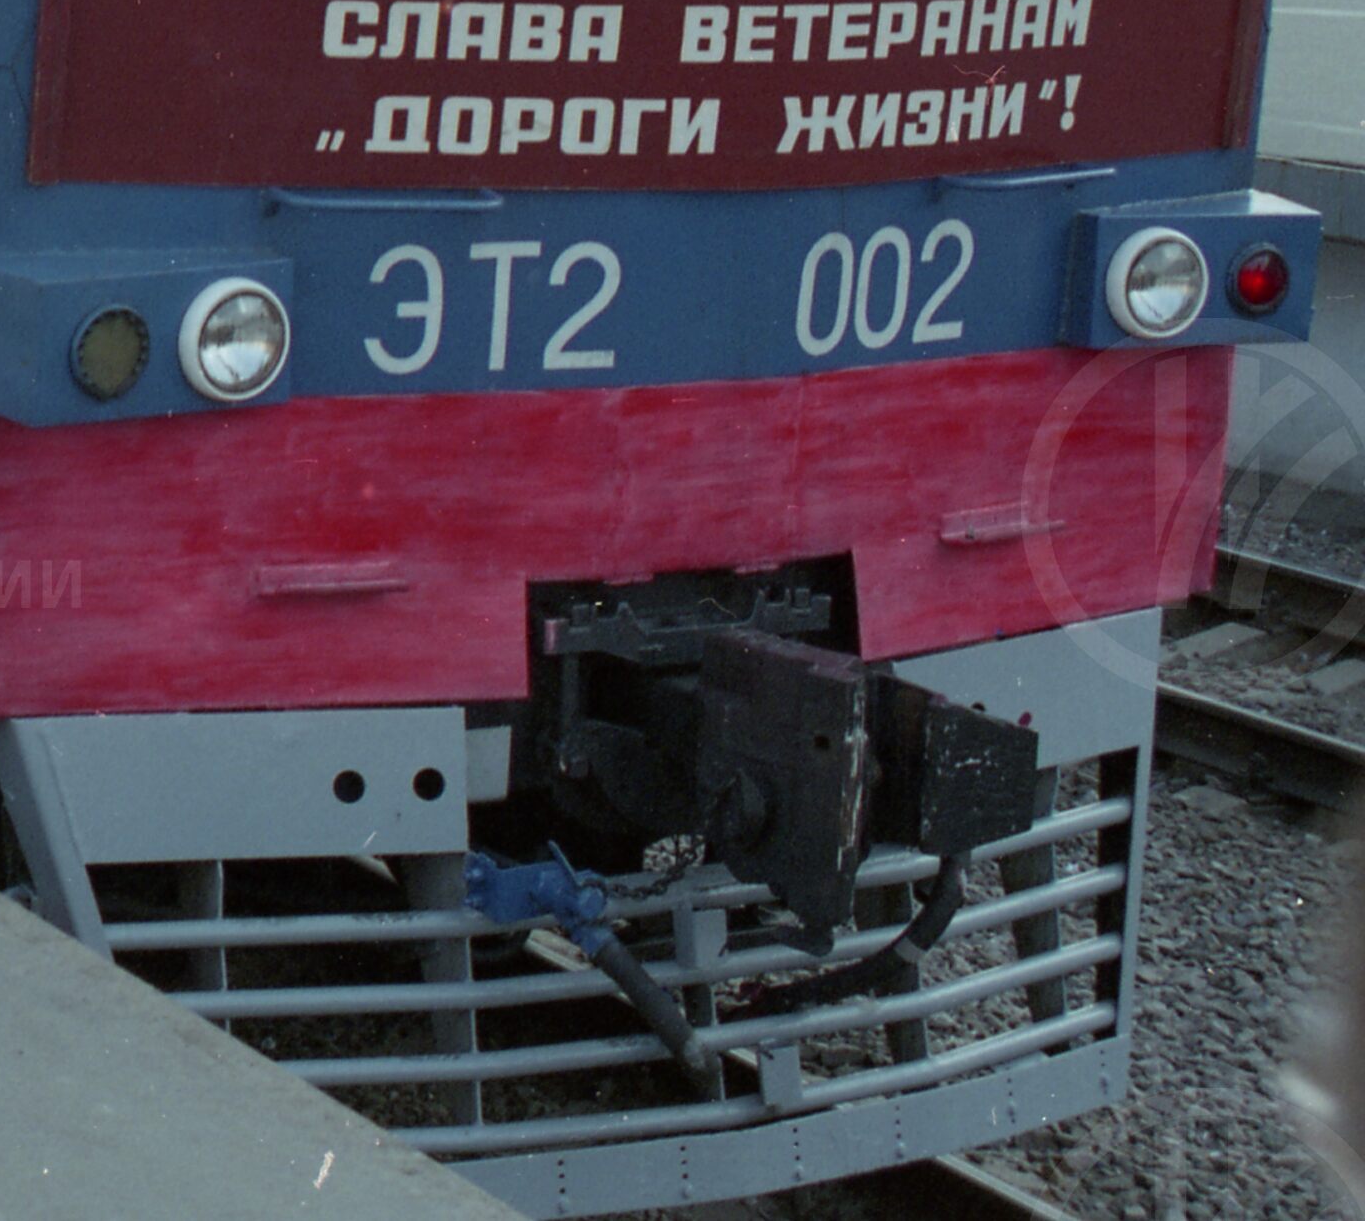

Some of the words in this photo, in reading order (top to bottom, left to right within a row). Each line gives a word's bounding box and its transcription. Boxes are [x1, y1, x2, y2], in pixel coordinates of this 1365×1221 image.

[322, 0, 624, 63] СЛАВА
[364, 240, 622, 375] ЭТ2
[795, 218, 975, 356] 002
